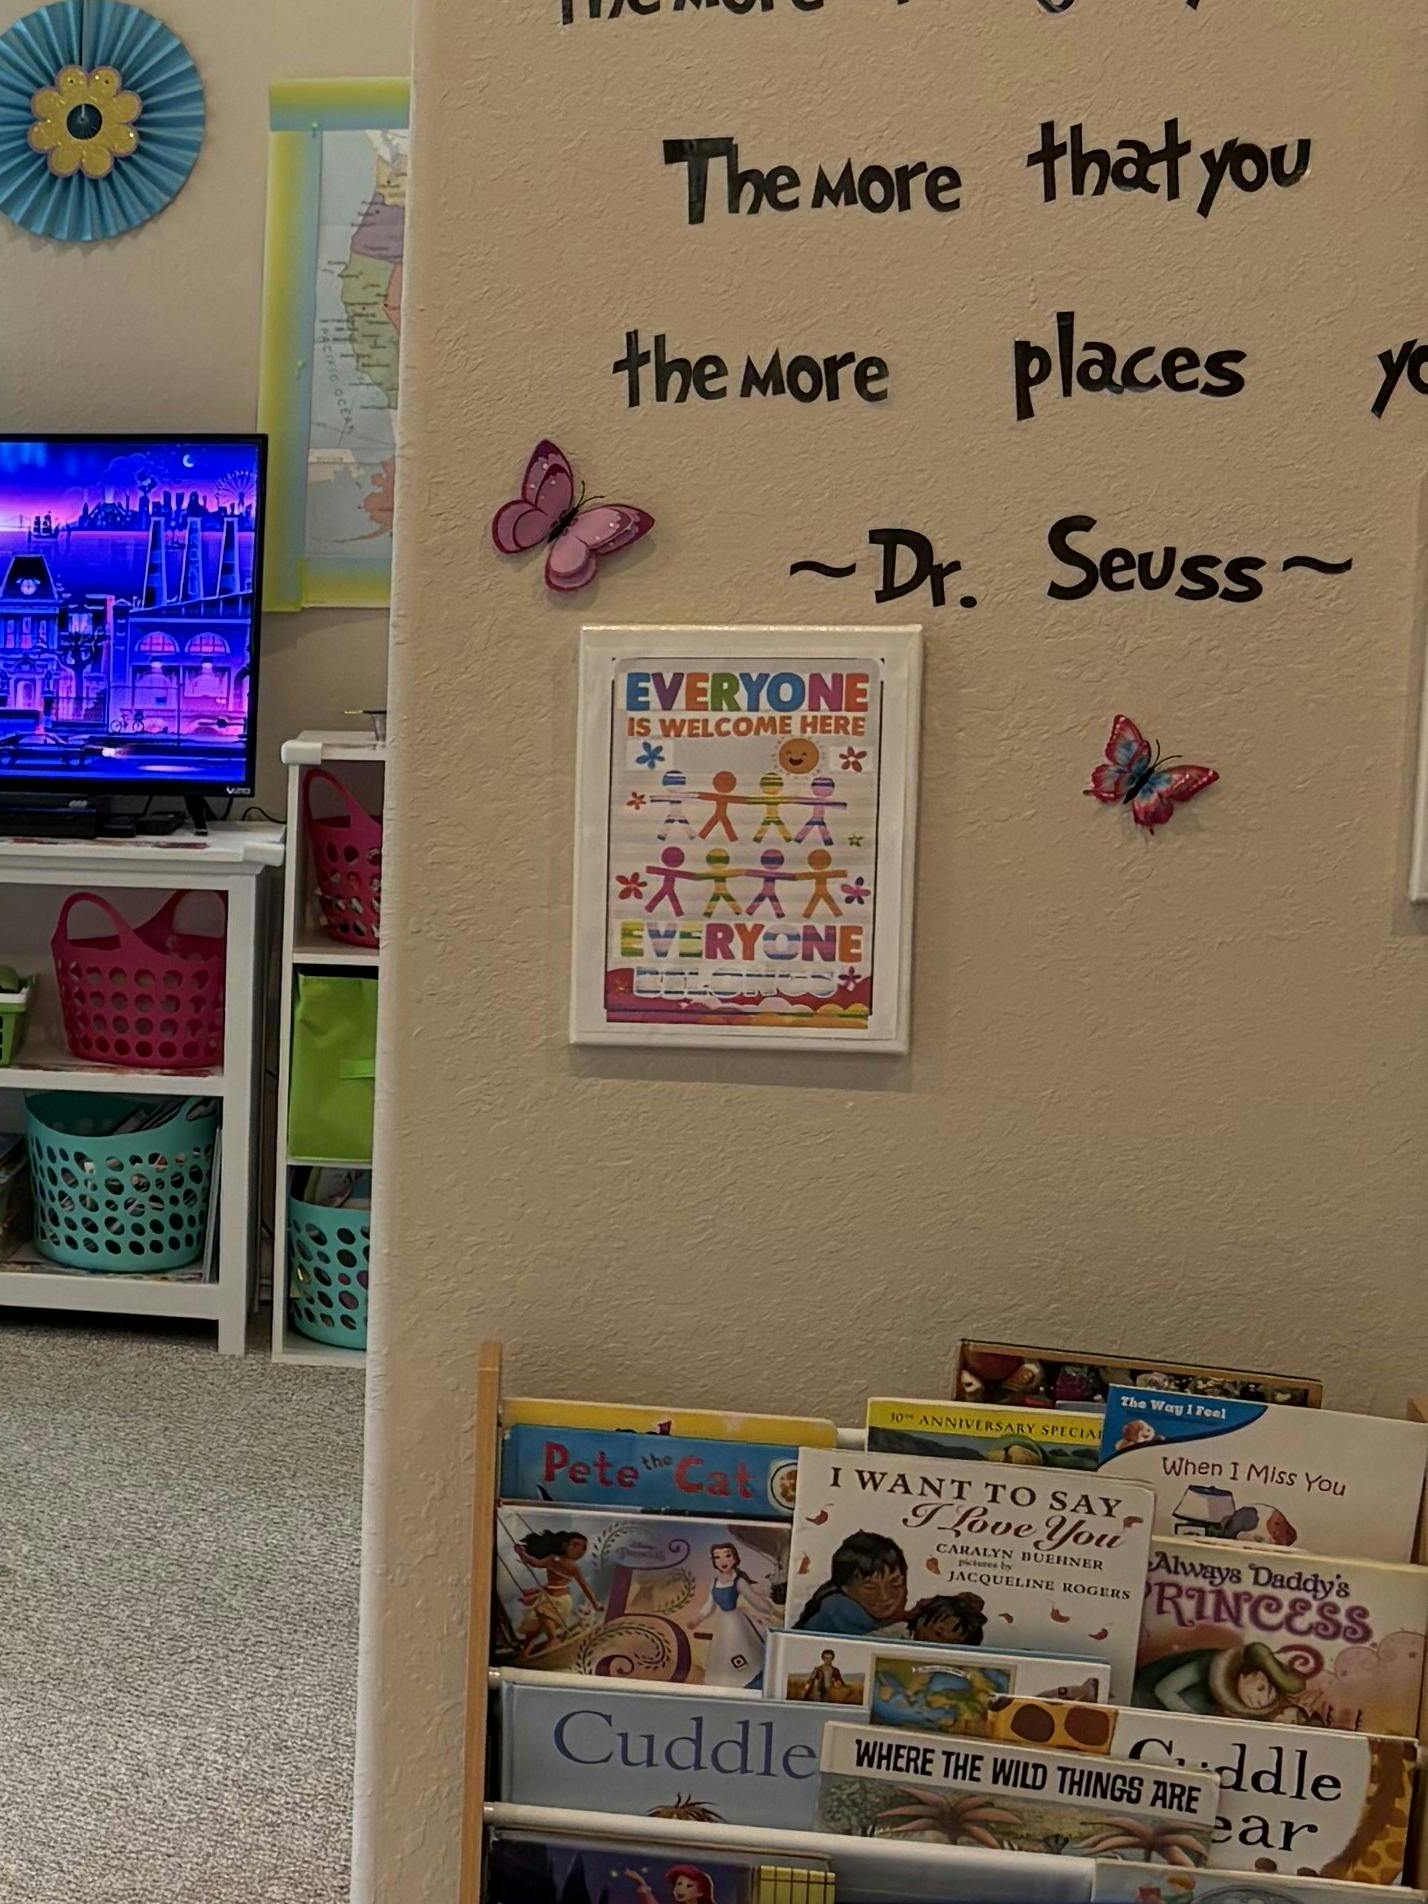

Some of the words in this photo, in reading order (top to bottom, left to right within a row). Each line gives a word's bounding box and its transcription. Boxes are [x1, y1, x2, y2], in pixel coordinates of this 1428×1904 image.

[662, 136, 801, 225] The
[1026, 117, 1192, 203] that
[1196, 137, 1312, 219] you
[612, 329, 729, 408] the
[1013, 310, 1248, 422] places
[626, 671, 870, 713] EVERYONE
[627, 716, 652, 737] IS
[658, 715, 793, 738] WELCOME
[799, 715, 866, 737] HERE
[620, 921, 864, 964] EVERYONE
[919, 1414, 1037, 1436] ANNIVERSARY
[1120, 1395, 1147, 1410] The
[1149, 1398, 1184, 1418] Way
[1195, 1405, 1227, 1420] Feel
[543, 1441, 640, 1490] Pete
[641, 1451, 674, 1472] the
[674, 1454, 758, 1500] Cat
[829, 1466, 843, 1488] I
[855, 1469, 973, 1502] WANT
[984, 1482, 1038, 1509] TO
[1048, 1491, 1123, 1518] SAY
[1160, 1456, 1223, 1478] When
[1229, 1460, 1241, 1481] I
[1246, 1463, 1299, 1487] Miss
[1304, 1471, 1347, 1498] You
[937, 1503, 1041, 1539] Love
[1033, 1514, 1129, 1552] You
[935, 1542, 1015, 1561] CARALYN
[1020, 1551, 1105, 1571] BUEHNER
[1147, 1550, 1242, 1588] Always
[1248, 1562, 1352, 1600] Daddy's
[947, 1570, 1056, 1593] JACQUELINE
[1061, 1582, 1132, 1601] ROGERS
[552, 1709, 818, 1780] Cuddle
[854, 1738, 935, 1777] WHERE
[941, 1749, 985, 1783] THE
[991, 1757, 1048, 1792] WILD
[1056, 1765, 1145, 1805] THINGS
[1149, 1779, 1202, 1815] ARE
[1128, 1737, 1343, 1802] Cddle
